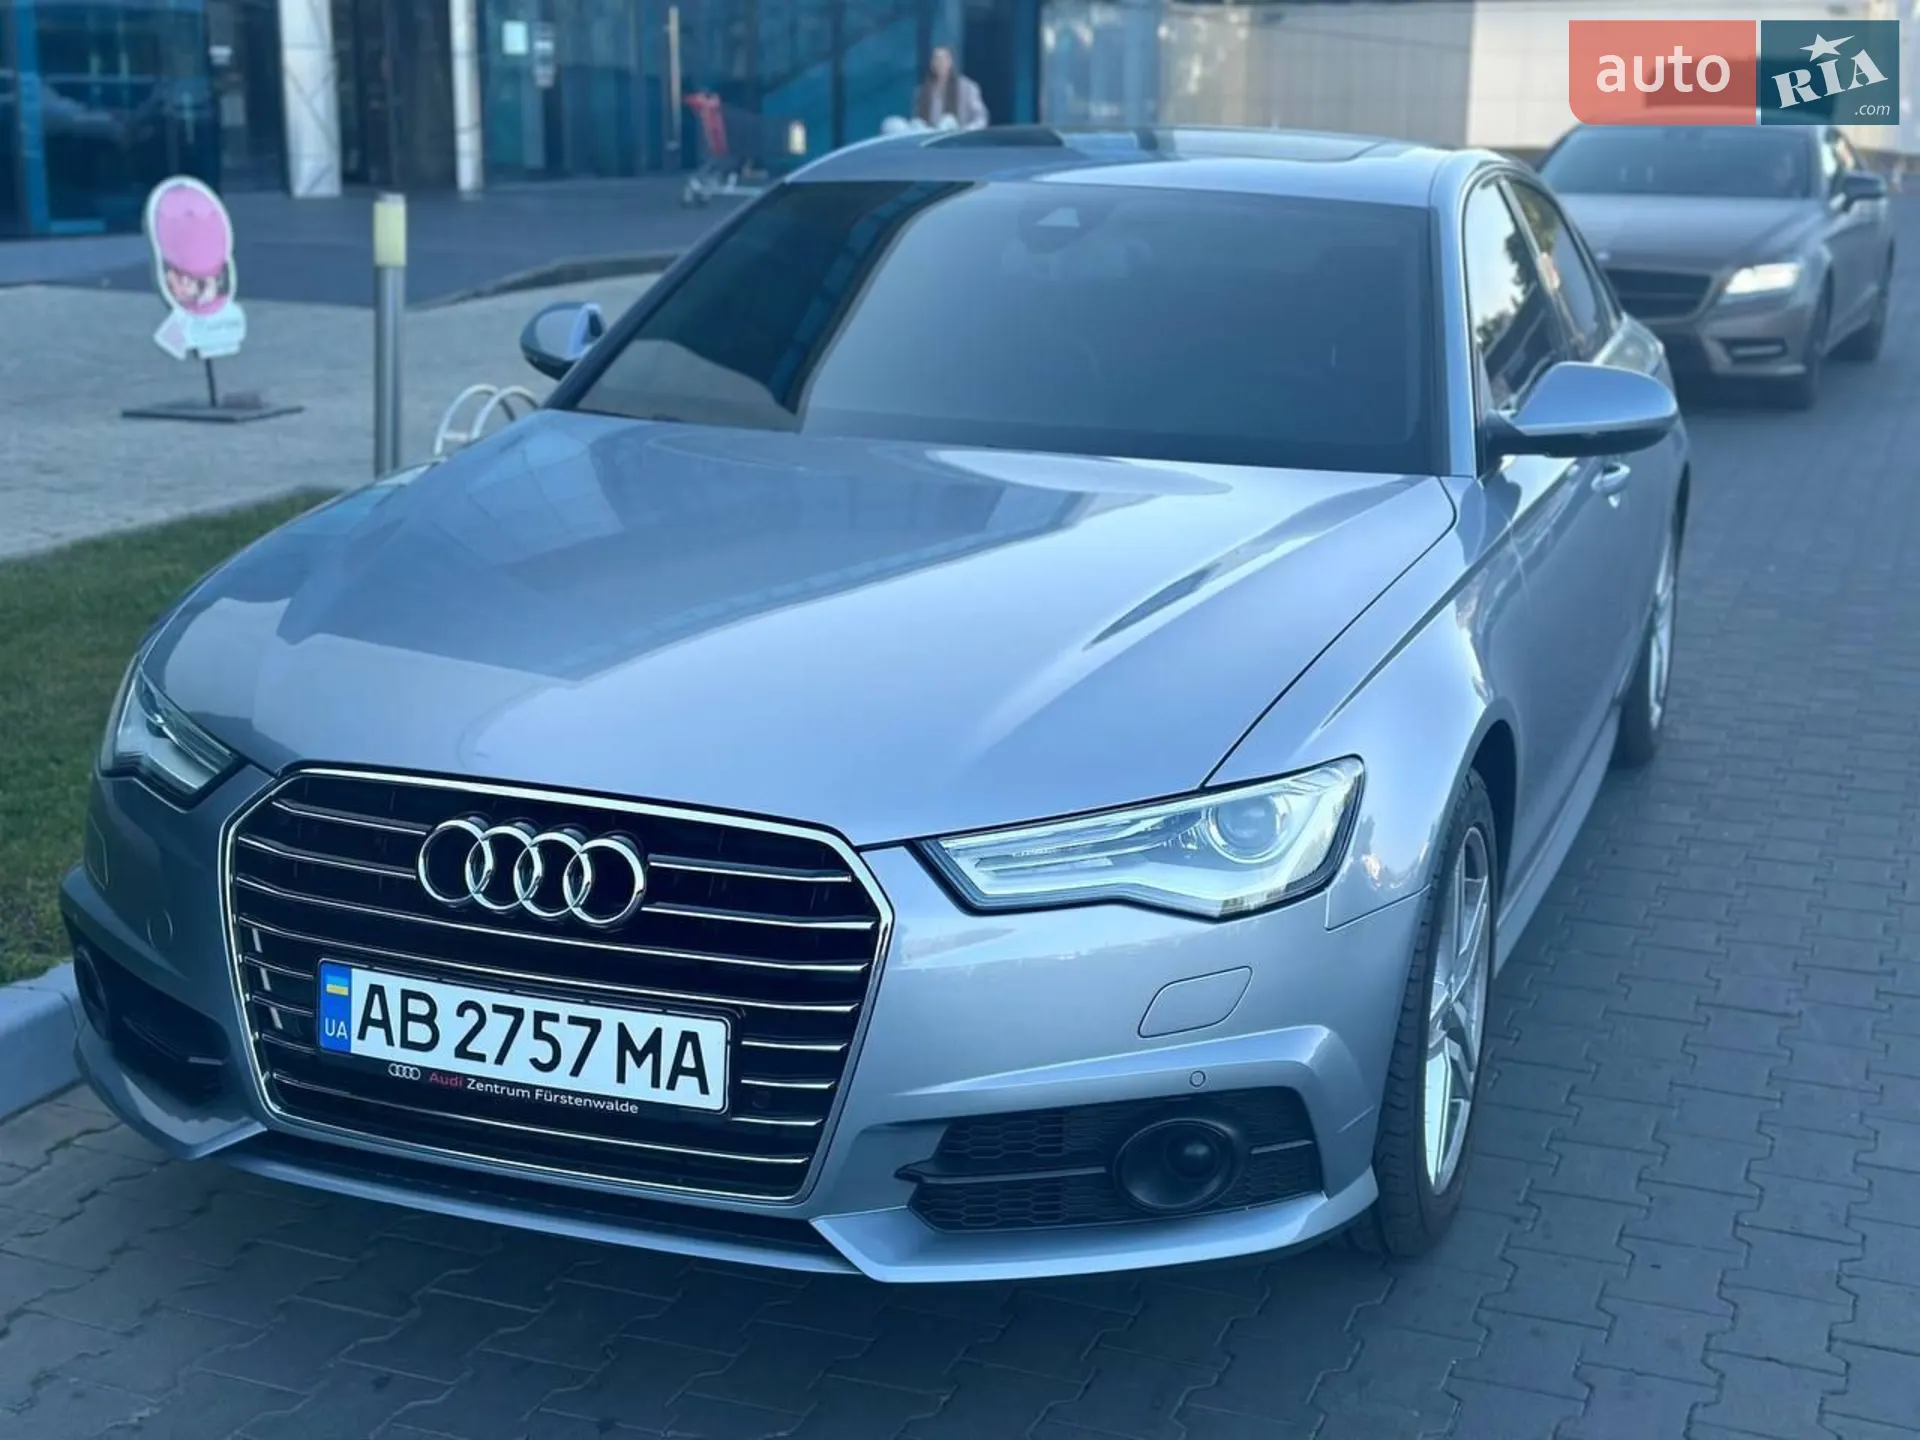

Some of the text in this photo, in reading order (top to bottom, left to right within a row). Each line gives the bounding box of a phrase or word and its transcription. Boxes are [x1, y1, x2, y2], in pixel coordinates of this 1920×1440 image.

[324, 1018, 349, 1040] UA
[356, 983, 711, 1096] AB 2757 MA
[429, 1072, 639, 1114] Audi Zentrum Fürstenwalde
